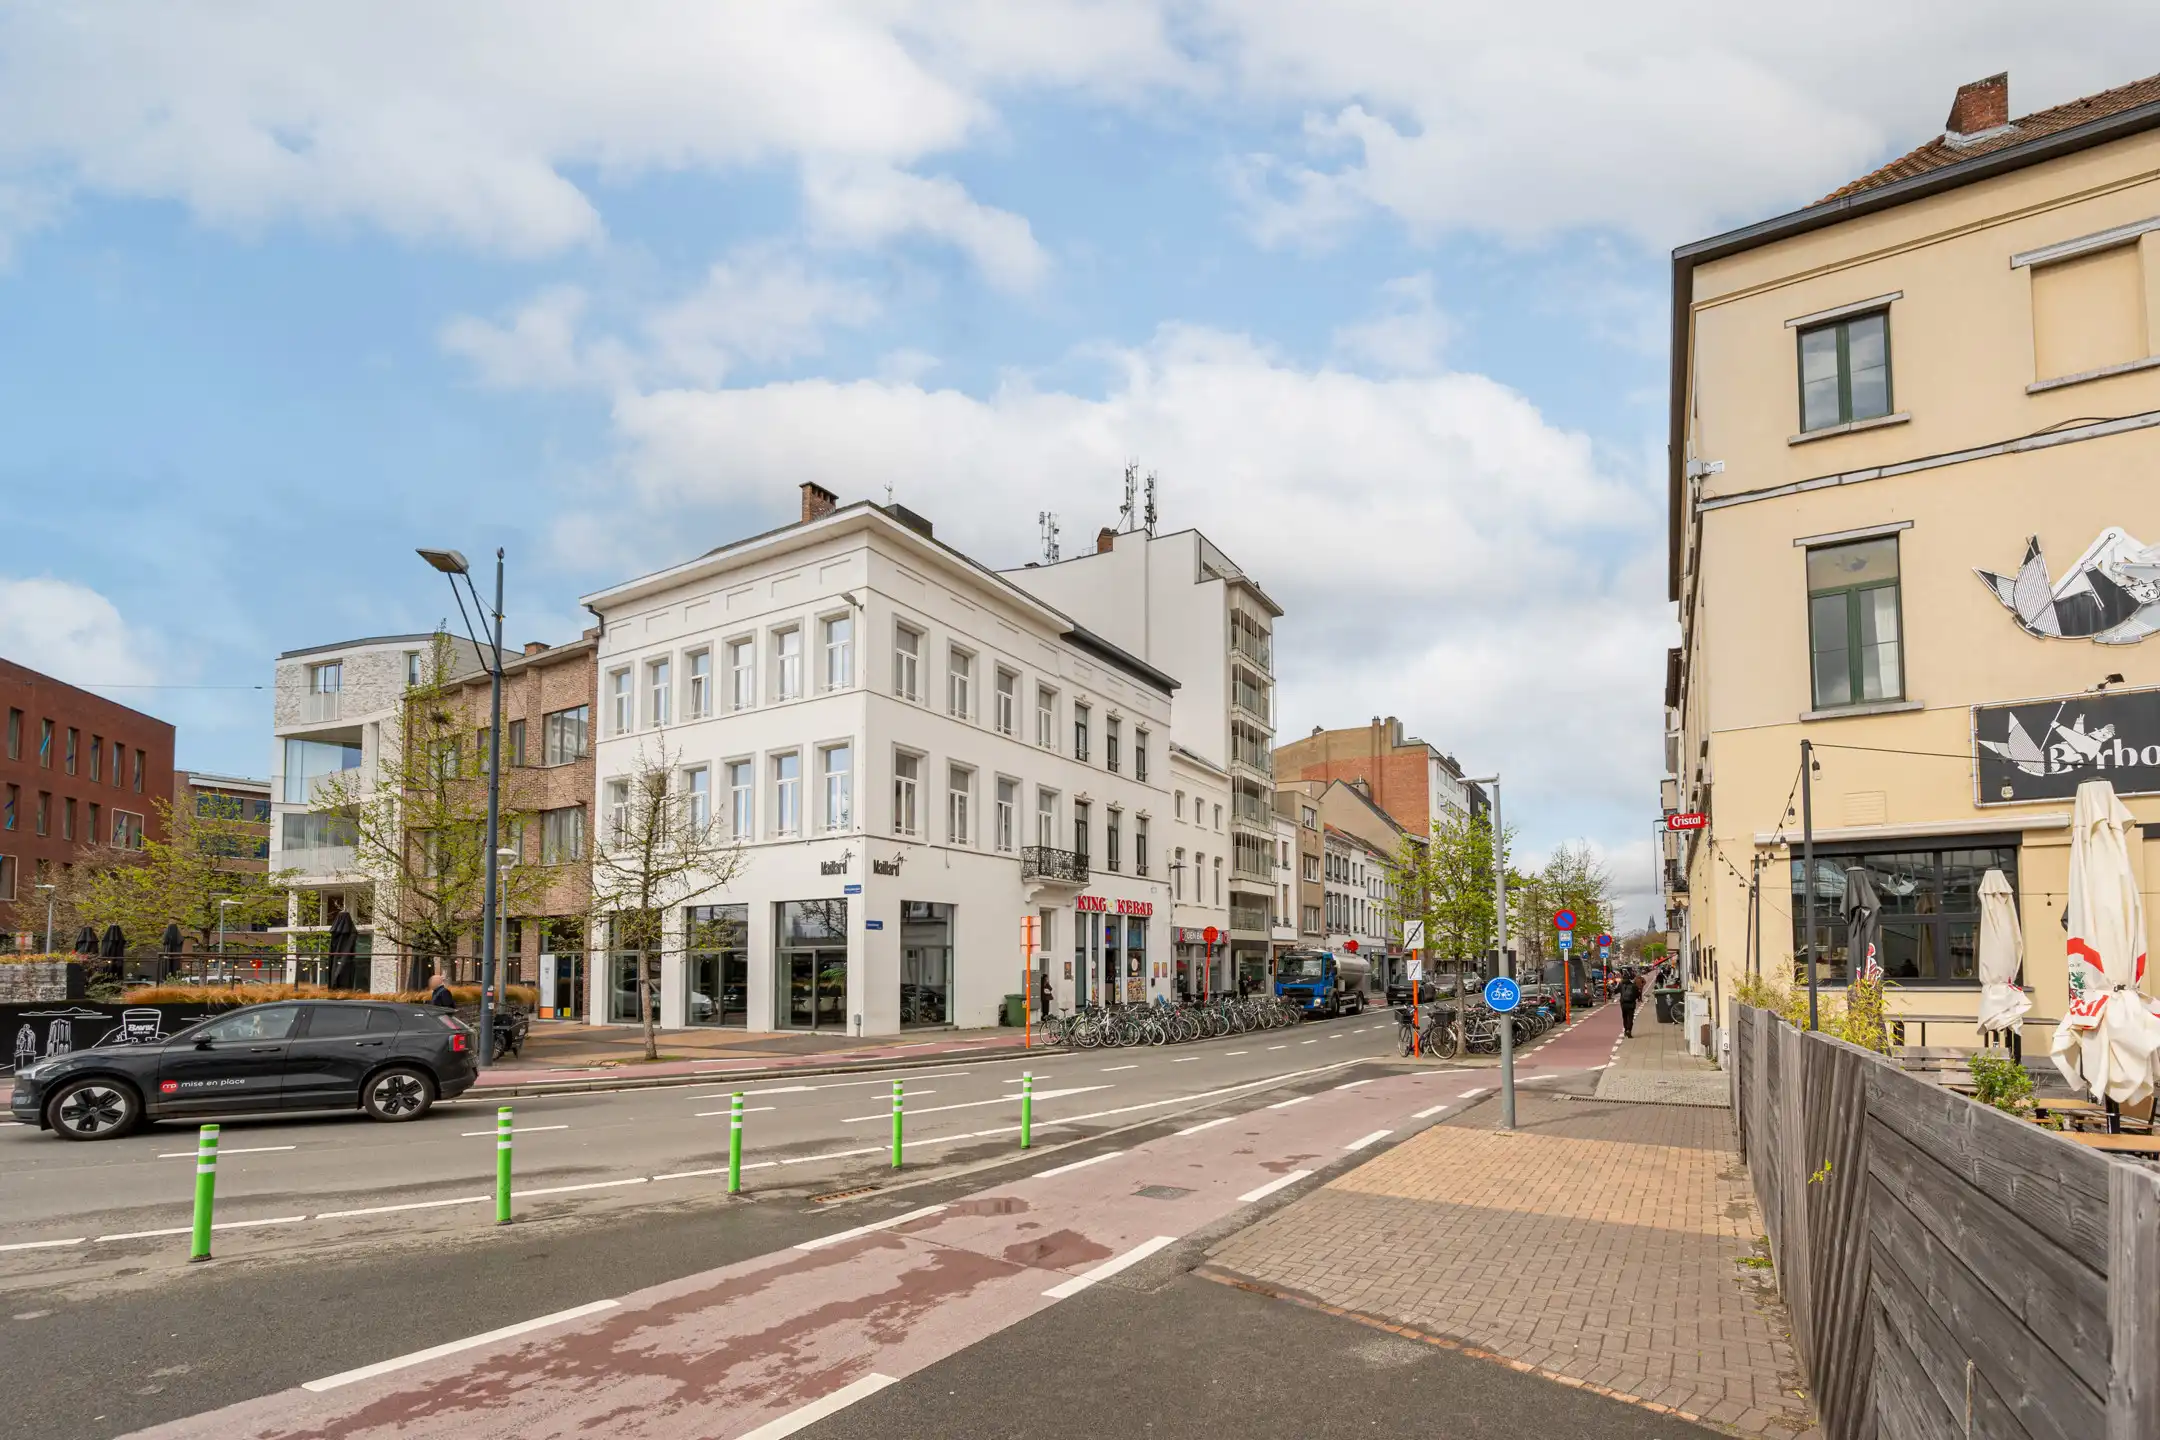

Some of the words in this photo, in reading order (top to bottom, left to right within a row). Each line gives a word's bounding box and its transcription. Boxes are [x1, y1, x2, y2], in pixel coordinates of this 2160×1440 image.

[1672, 815, 1701, 827] Cristal
[1077, 895, 1107, 913] KING
[1117, 899, 1153, 916] KEBAB
[181, 1080, 204, 1088] mise
[220, 1078, 246, 1087] place
